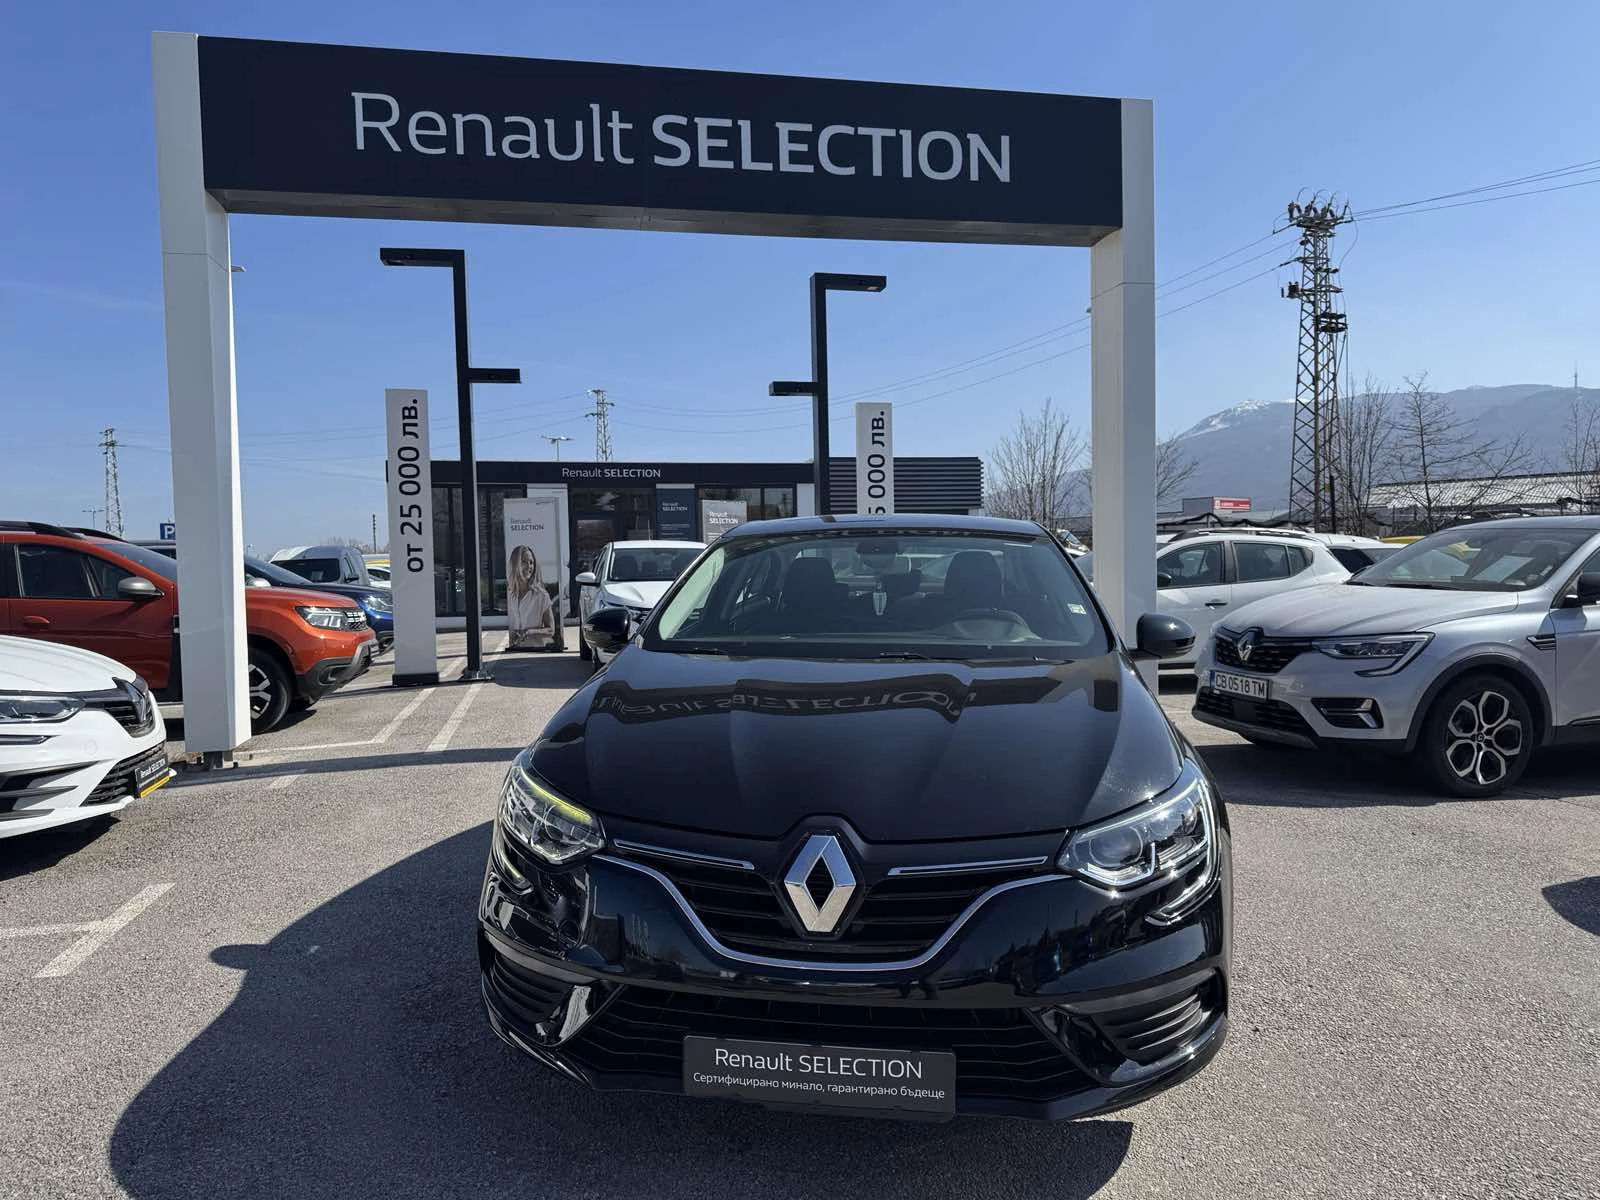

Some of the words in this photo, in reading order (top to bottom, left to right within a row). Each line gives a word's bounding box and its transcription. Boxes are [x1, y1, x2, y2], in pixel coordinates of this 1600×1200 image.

[351, 91, 635, 165] Renault
[652, 113, 1011, 183] SELECTION
[402, 398, 419, 439] лв.
[871, 410, 886, 447] лв.
[397, 446, 421, 496] 000
[562, 467, 602, 478] Renault
[603, 468, 661, 478] SELECTION
[867, 453, 886, 499] 000
[164, 525, 175, 539] P
[399, 503, 423, 536] 25
[406, 543, 424, 573] от
[1228, 676, 1250, 693] 0518
[1252, 680, 1265, 697] TM
[715, 1048, 793, 1072] Renault
[799, 1055, 922, 1079] SELECTION
[693, 1072, 779, 1088] Сертифицирано
[781, 1080, 825, 1093] минало,
[827, 1084, 898, 1097] гарантирано
[900, 1086, 945, 1099] бъдеще
